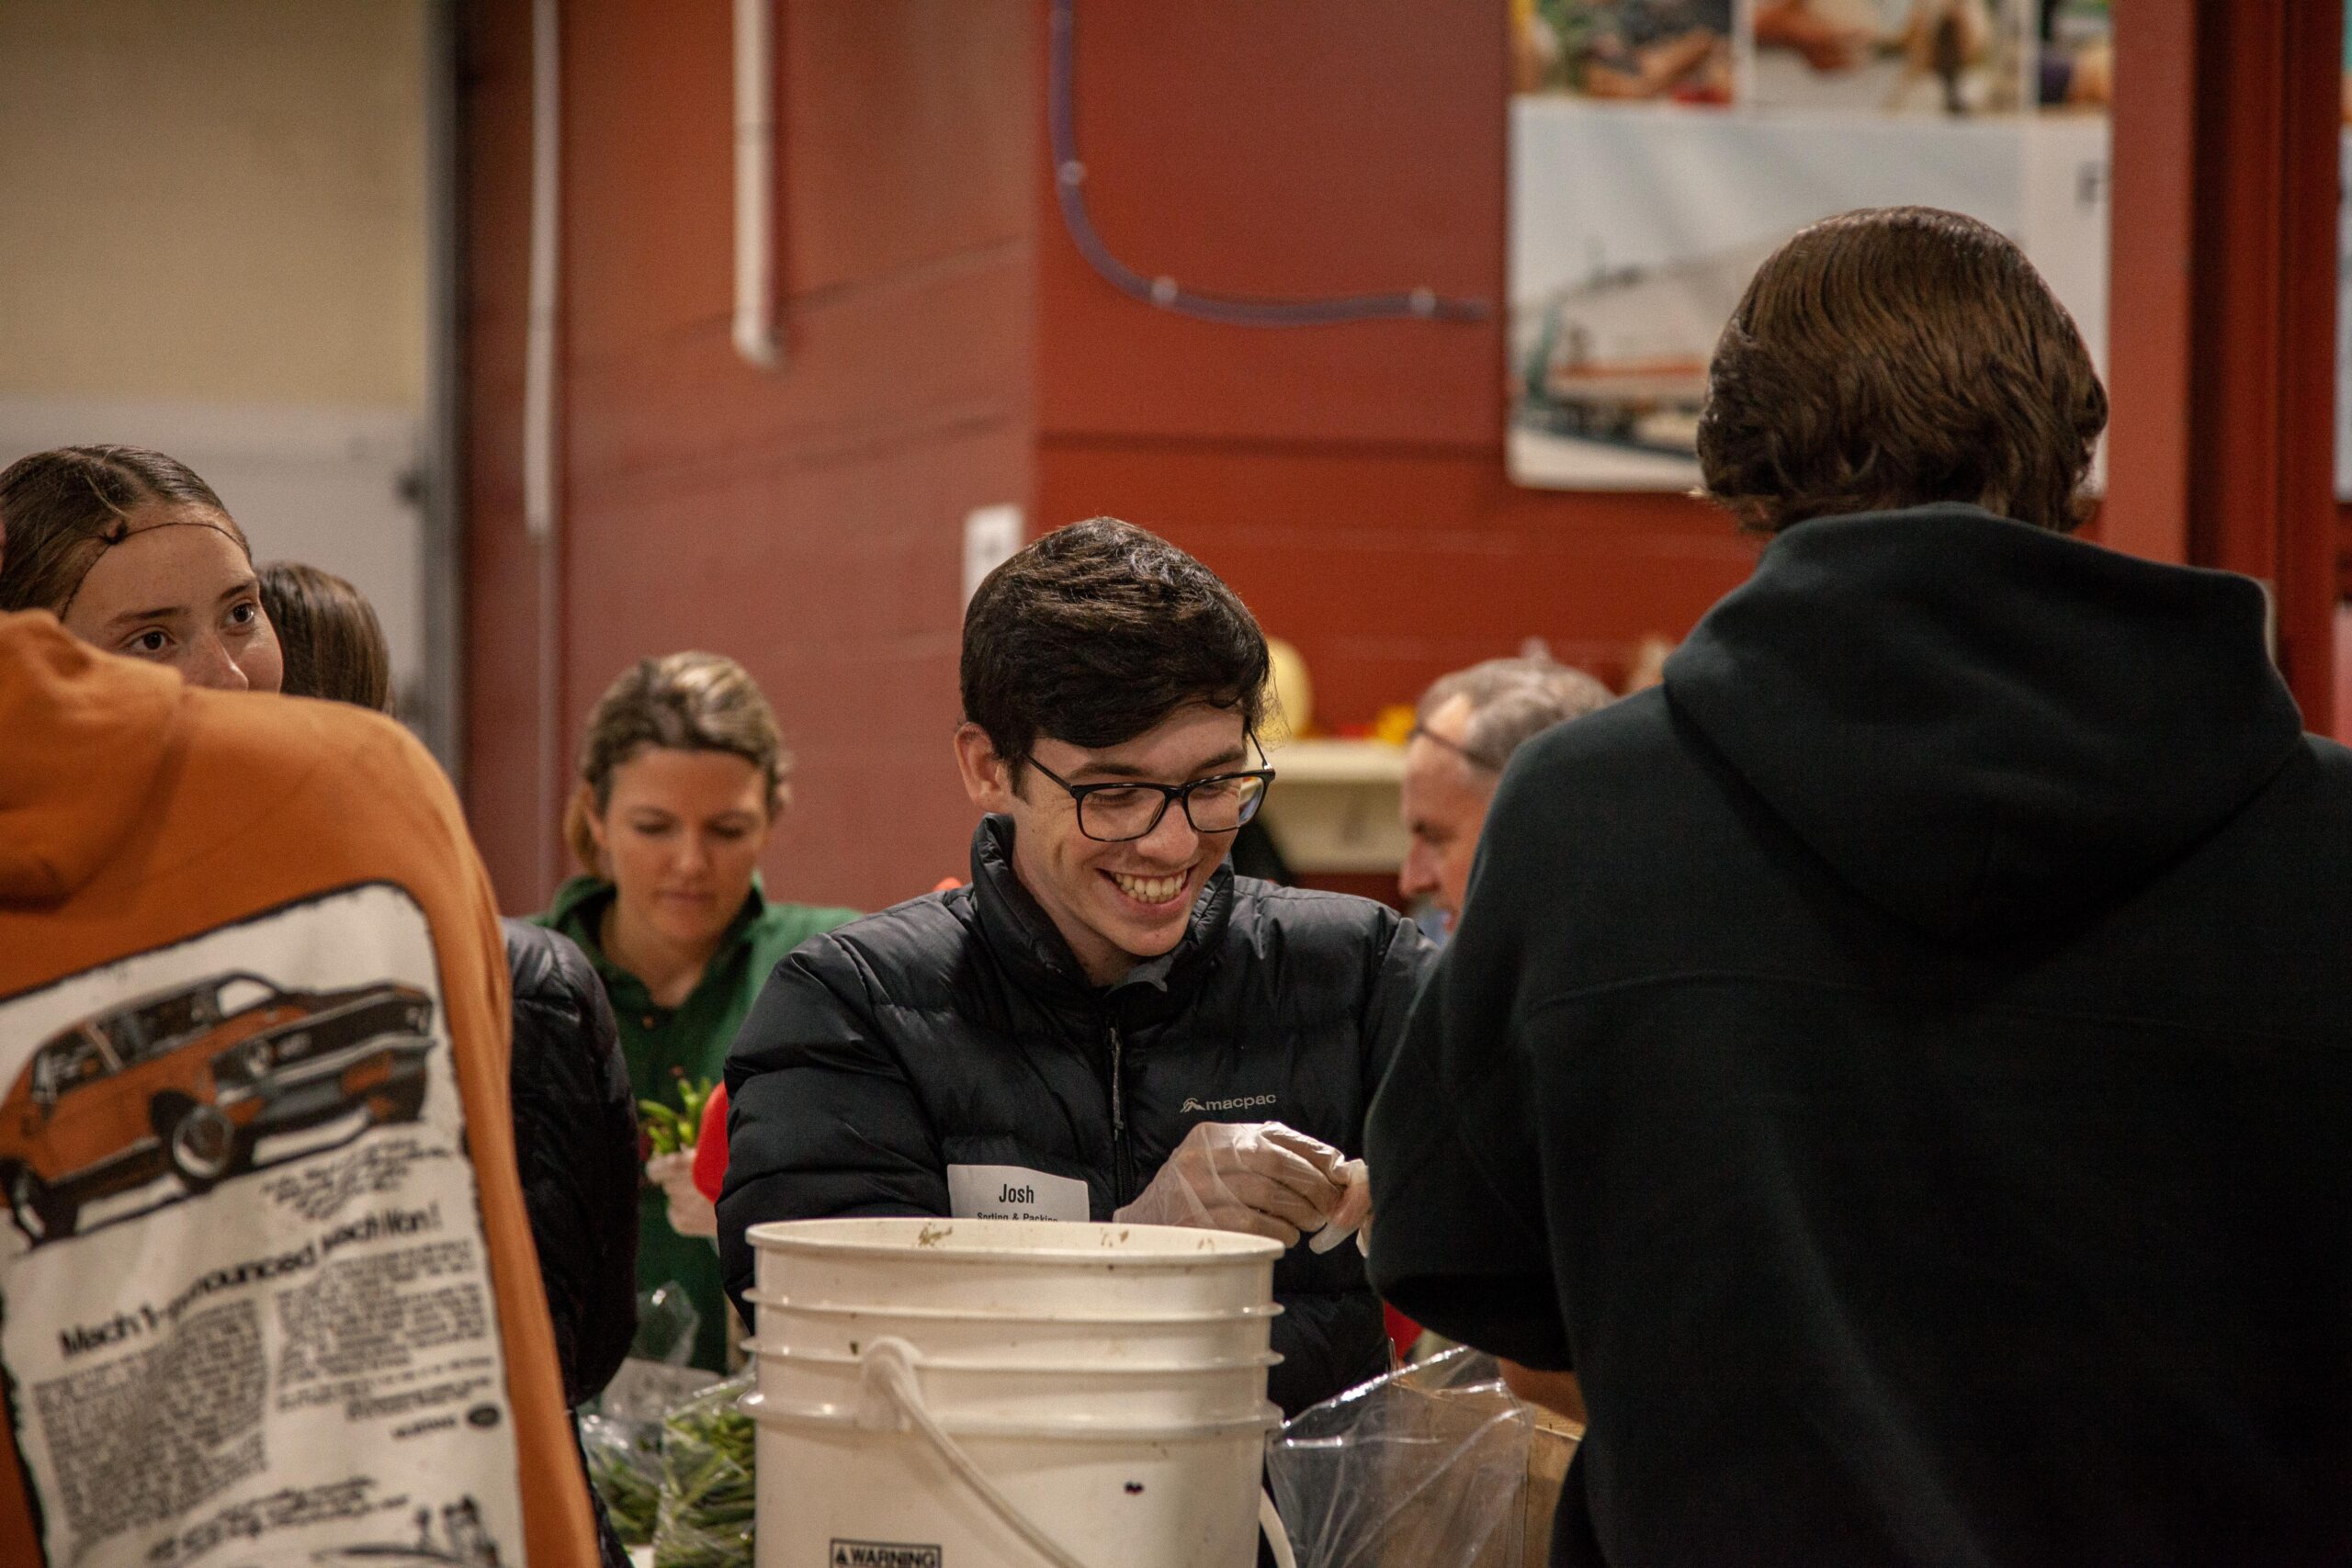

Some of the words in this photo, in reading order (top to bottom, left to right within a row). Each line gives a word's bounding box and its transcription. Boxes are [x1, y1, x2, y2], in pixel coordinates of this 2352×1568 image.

[1205, 1094, 1277, 1111] macpac
[998, 1183, 1035, 1205] Josh
[59, 1311, 141, 1358] Mach
[851, 1548, 935, 1566] WARNING
